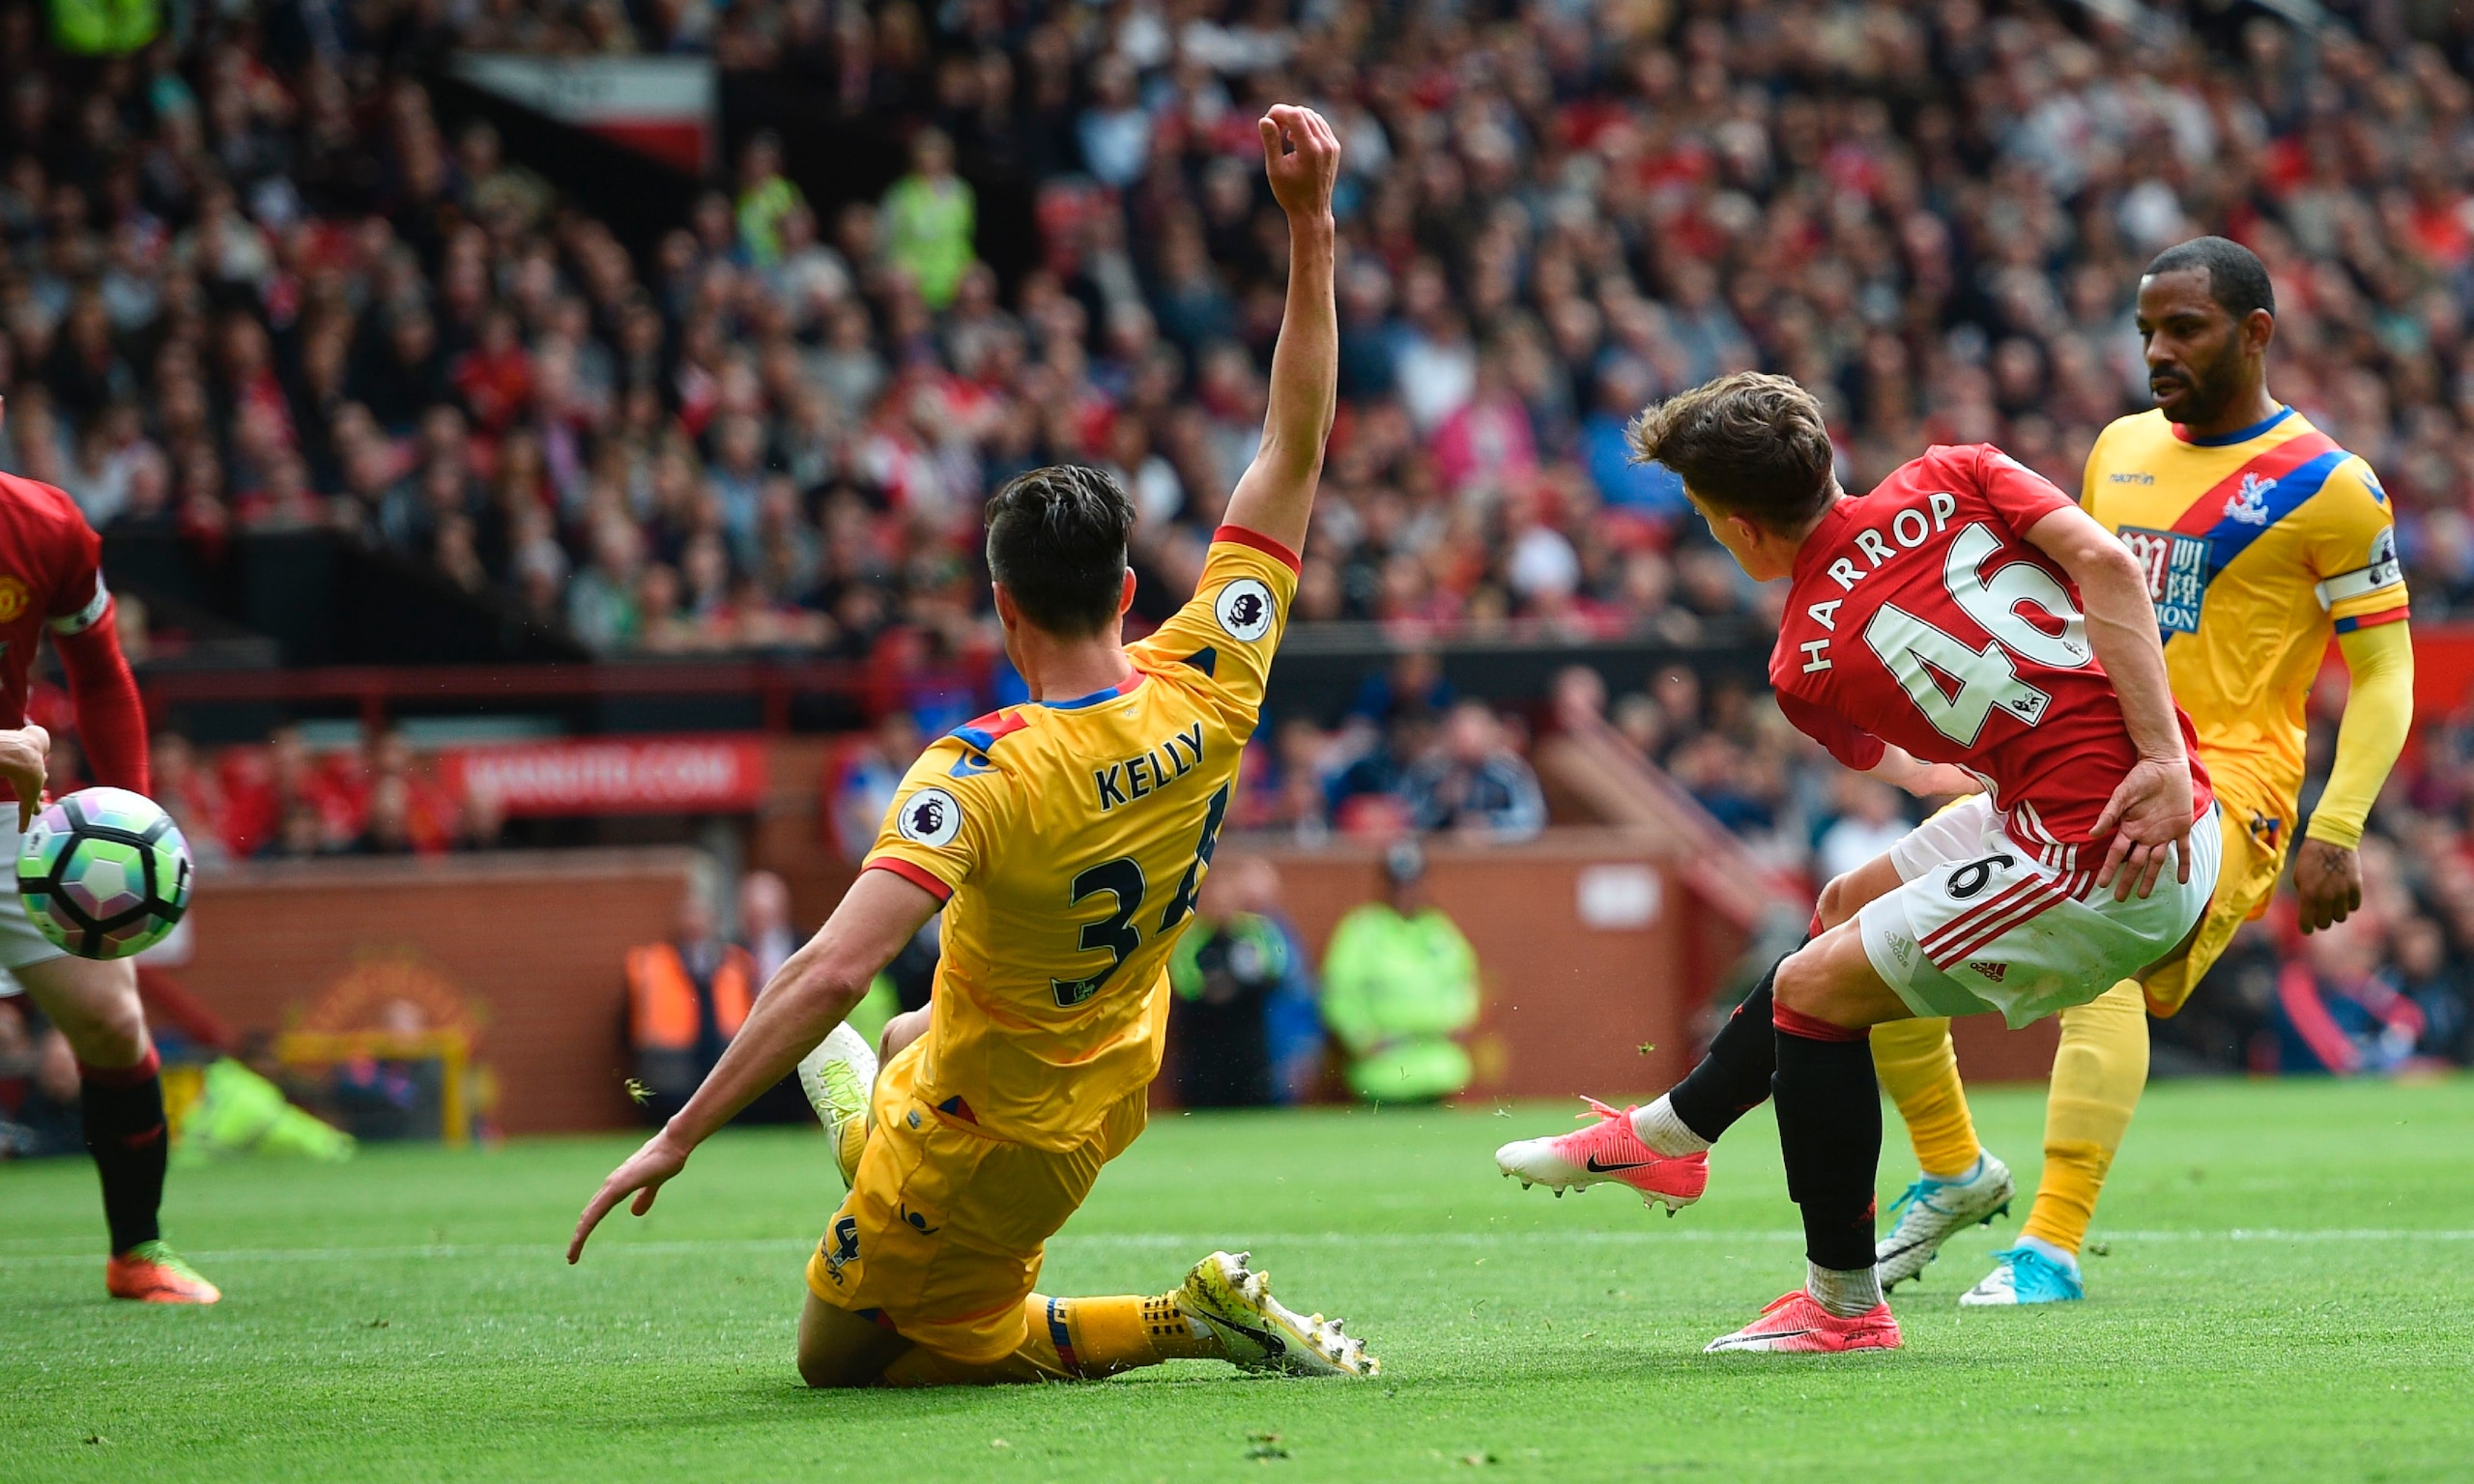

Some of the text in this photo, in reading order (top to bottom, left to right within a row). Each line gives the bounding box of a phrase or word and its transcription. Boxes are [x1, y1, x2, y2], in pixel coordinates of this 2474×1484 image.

[1799, 492, 1957, 674] HARROP
[1862, 521, 2094, 749] 46
[1094, 720, 1205, 813] KELLY
[1884, 930, 1910, 968] adidas
[1970, 962, 2004, 983] adidas
